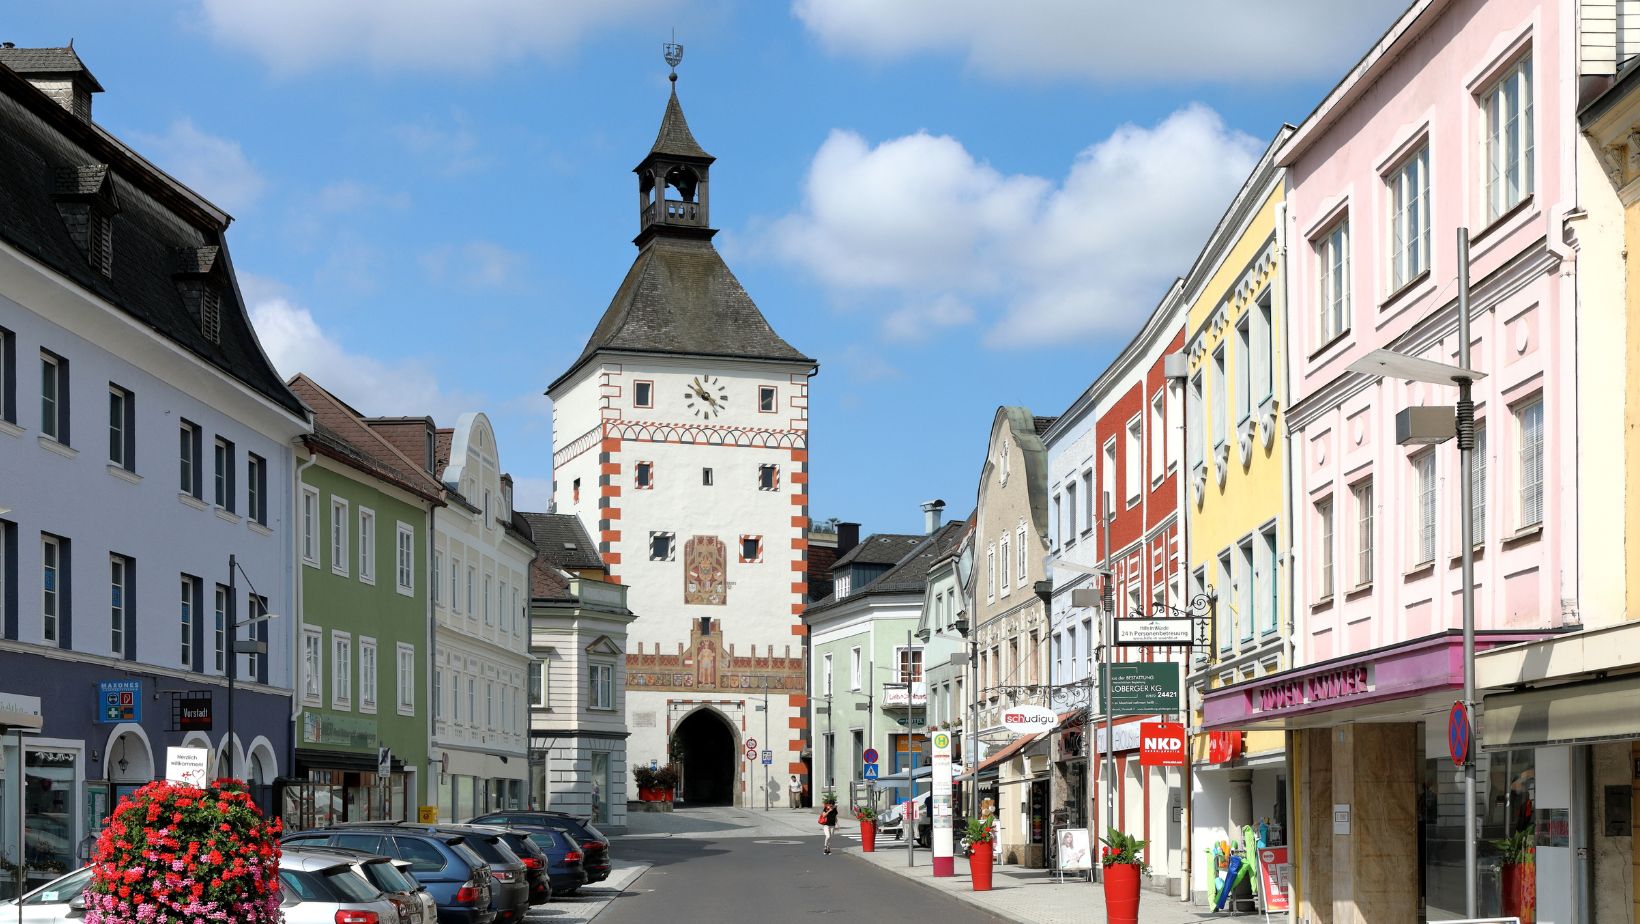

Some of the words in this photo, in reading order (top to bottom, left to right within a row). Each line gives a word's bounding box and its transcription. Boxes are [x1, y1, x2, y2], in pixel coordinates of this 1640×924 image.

[184, 708, 208, 718] Vorstadt
[1006, 714, 1054, 725] schudigu
[1144, 738, 1181, 750] NKD
